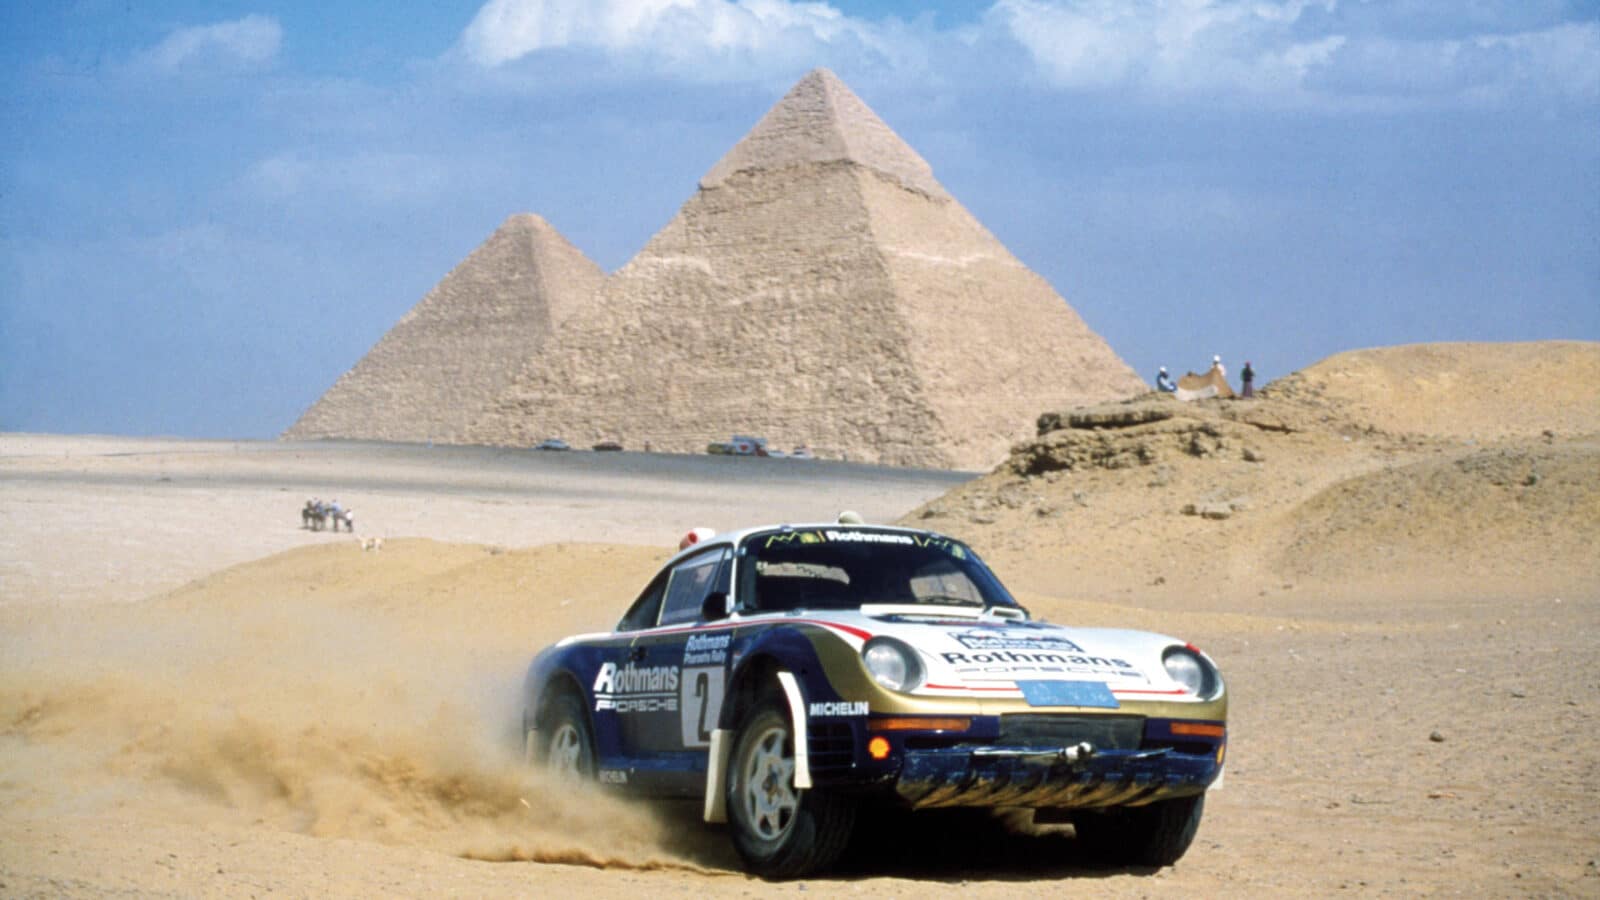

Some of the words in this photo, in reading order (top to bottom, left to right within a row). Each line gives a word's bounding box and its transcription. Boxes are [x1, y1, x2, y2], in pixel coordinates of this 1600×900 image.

[825, 531, 914, 545] Rothmans
[685, 633, 730, 651] Rothmans
[940, 650, 1134, 669] Rothmans
[593, 661, 679, 693] Rothmans
[594, 698, 678, 713] PORSCHE
[695, 671, 711, 742] 2
[809, 701, 869, 716] MICHELIN
